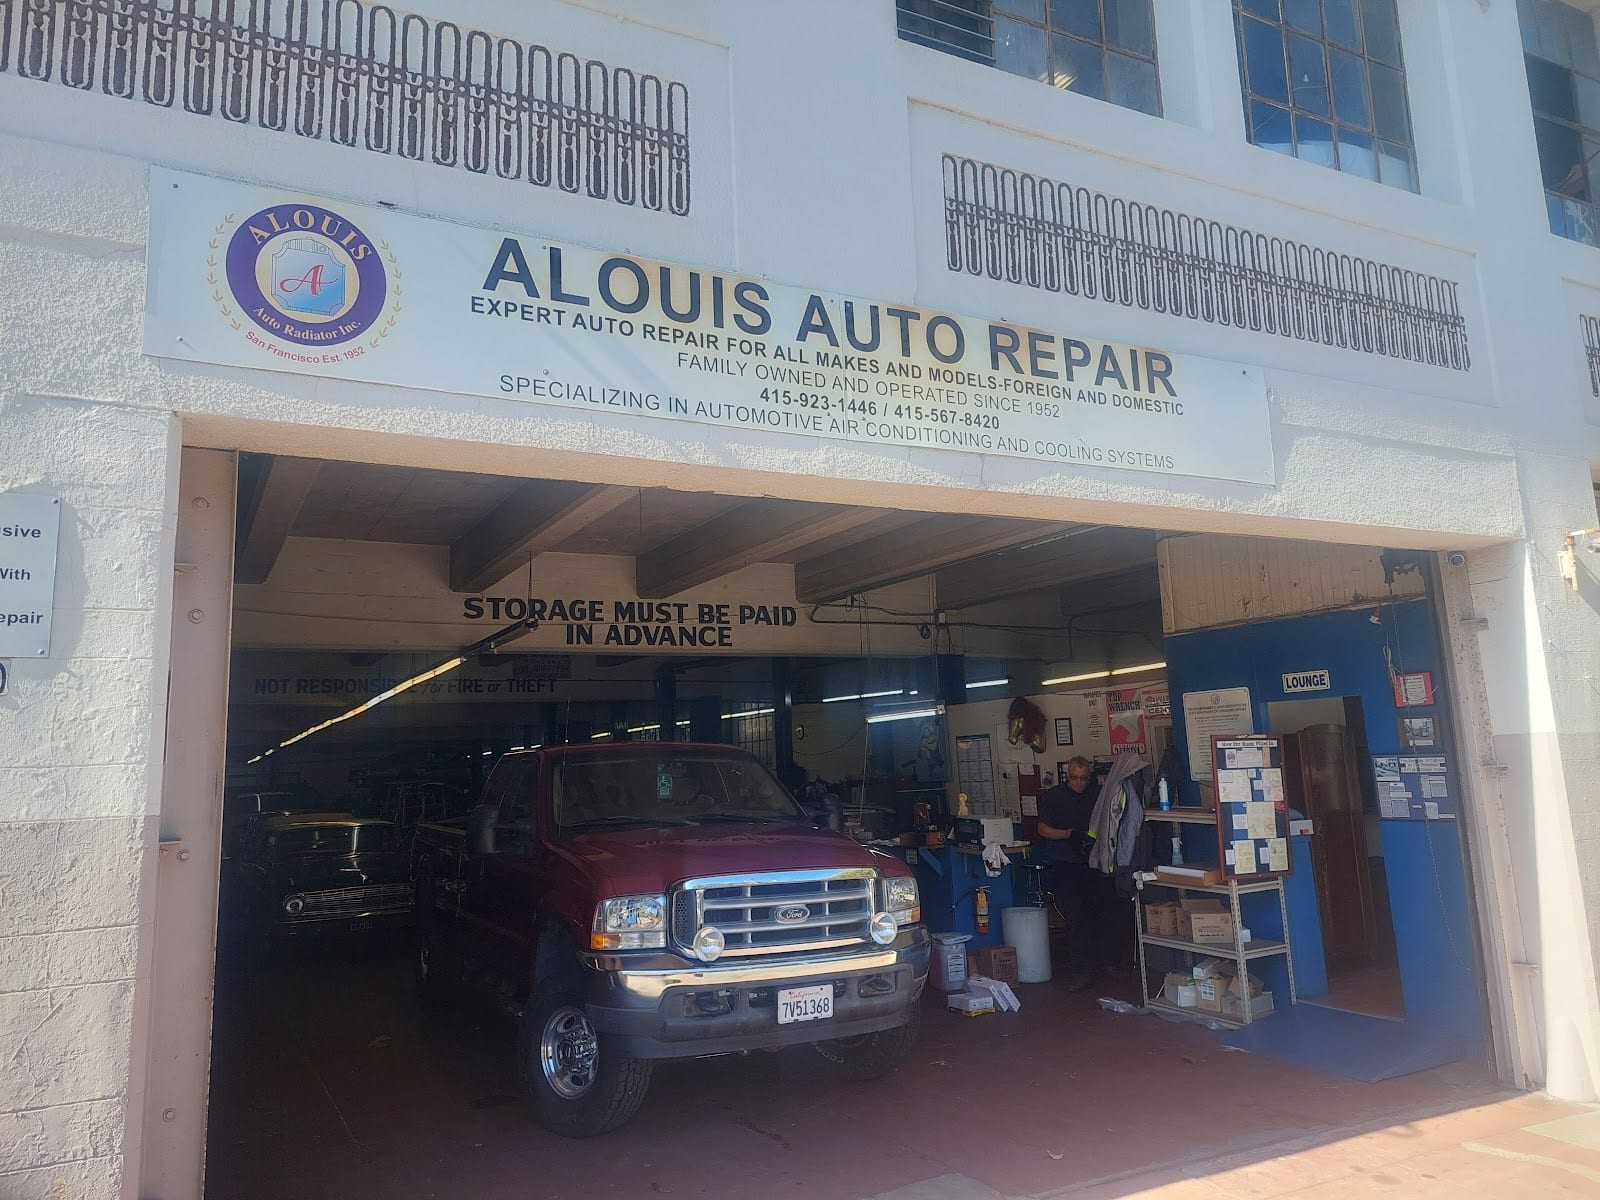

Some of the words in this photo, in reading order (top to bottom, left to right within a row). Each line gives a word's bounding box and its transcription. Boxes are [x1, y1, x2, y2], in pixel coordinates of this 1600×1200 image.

[247, 209, 373, 261] ALOUIS
[252, 305, 281, 330] Auto
[283, 323, 338, 342] Radiator
[337, 319, 363, 336] Inc.
[482, 237, 772, 336] ALOUIS
[795, 294, 966, 365] AUTO
[988, 324, 1178, 398] REPAIR
[245, 330, 266, 349] San
[266, 342, 320, 364] Francisco
[322, 352, 344, 364] Est.
[343, 346, 366, 361] 1952
[471, 295, 566, 327] EXPERT
[571, 312, 635, 338] AUTO
[642, 323, 720, 351] REPAIR
[726, 337, 767, 359] FOR
[773, 345, 810, 365] ALL
[816, 352, 880, 375] MAKES
[885, 361, 922, 380] AND
[1076, 388, 1109, 406] AND
[1111, 394, 1185, 417] DOMESTIC
[677, 352, 748, 378] FAMILY
[754, 363, 826, 389] OWNED
[831, 375, 870, 394] AND
[875, 380, 968, 406] OPERATED
[973, 393, 1022, 413] SINCE
[1026, 400, 1061, 419] 1952
[499, 374, 661, 412] SPECIALIZING
[668, 396, 688, 415] IN
[694, 400, 824, 432] AUTOMOTIVE
[829, 417, 860, 435] AIR
[865, 421, 993, 450] CONDITIONING
[996, 435, 1030, 454] AND
[1034, 439, 1103, 462] COOLING
[1106, 448, 1175, 470] SYSTEMS
[759, 387, 878, 417] 415-923-1446
[894, 403, 1001, 431] 415-567-8420
[0, 524, 42, 539] sive
[463, 597, 605, 622] STORAGE
[613, 602, 691, 624] MUST
[698, 603, 730, 625] BE
[739, 605, 798, 627] PAID
[565, 623, 593, 645] IN
[603, 624, 733, 647] ADVANCE
[255, 678, 290, 695] NOT
[448, 679, 484, 693] FIRE
[487, 682, 501, 694] or
[507, 679, 556, 694] THEFT
[1285, 673, 1327, 689] LOUNGE
[1108, 700, 1141, 712] WRENCH
[786, 909, 804, 919] Ford
[782, 997, 830, 1019] 7V51368
[789, 991, 821, 1000] California
